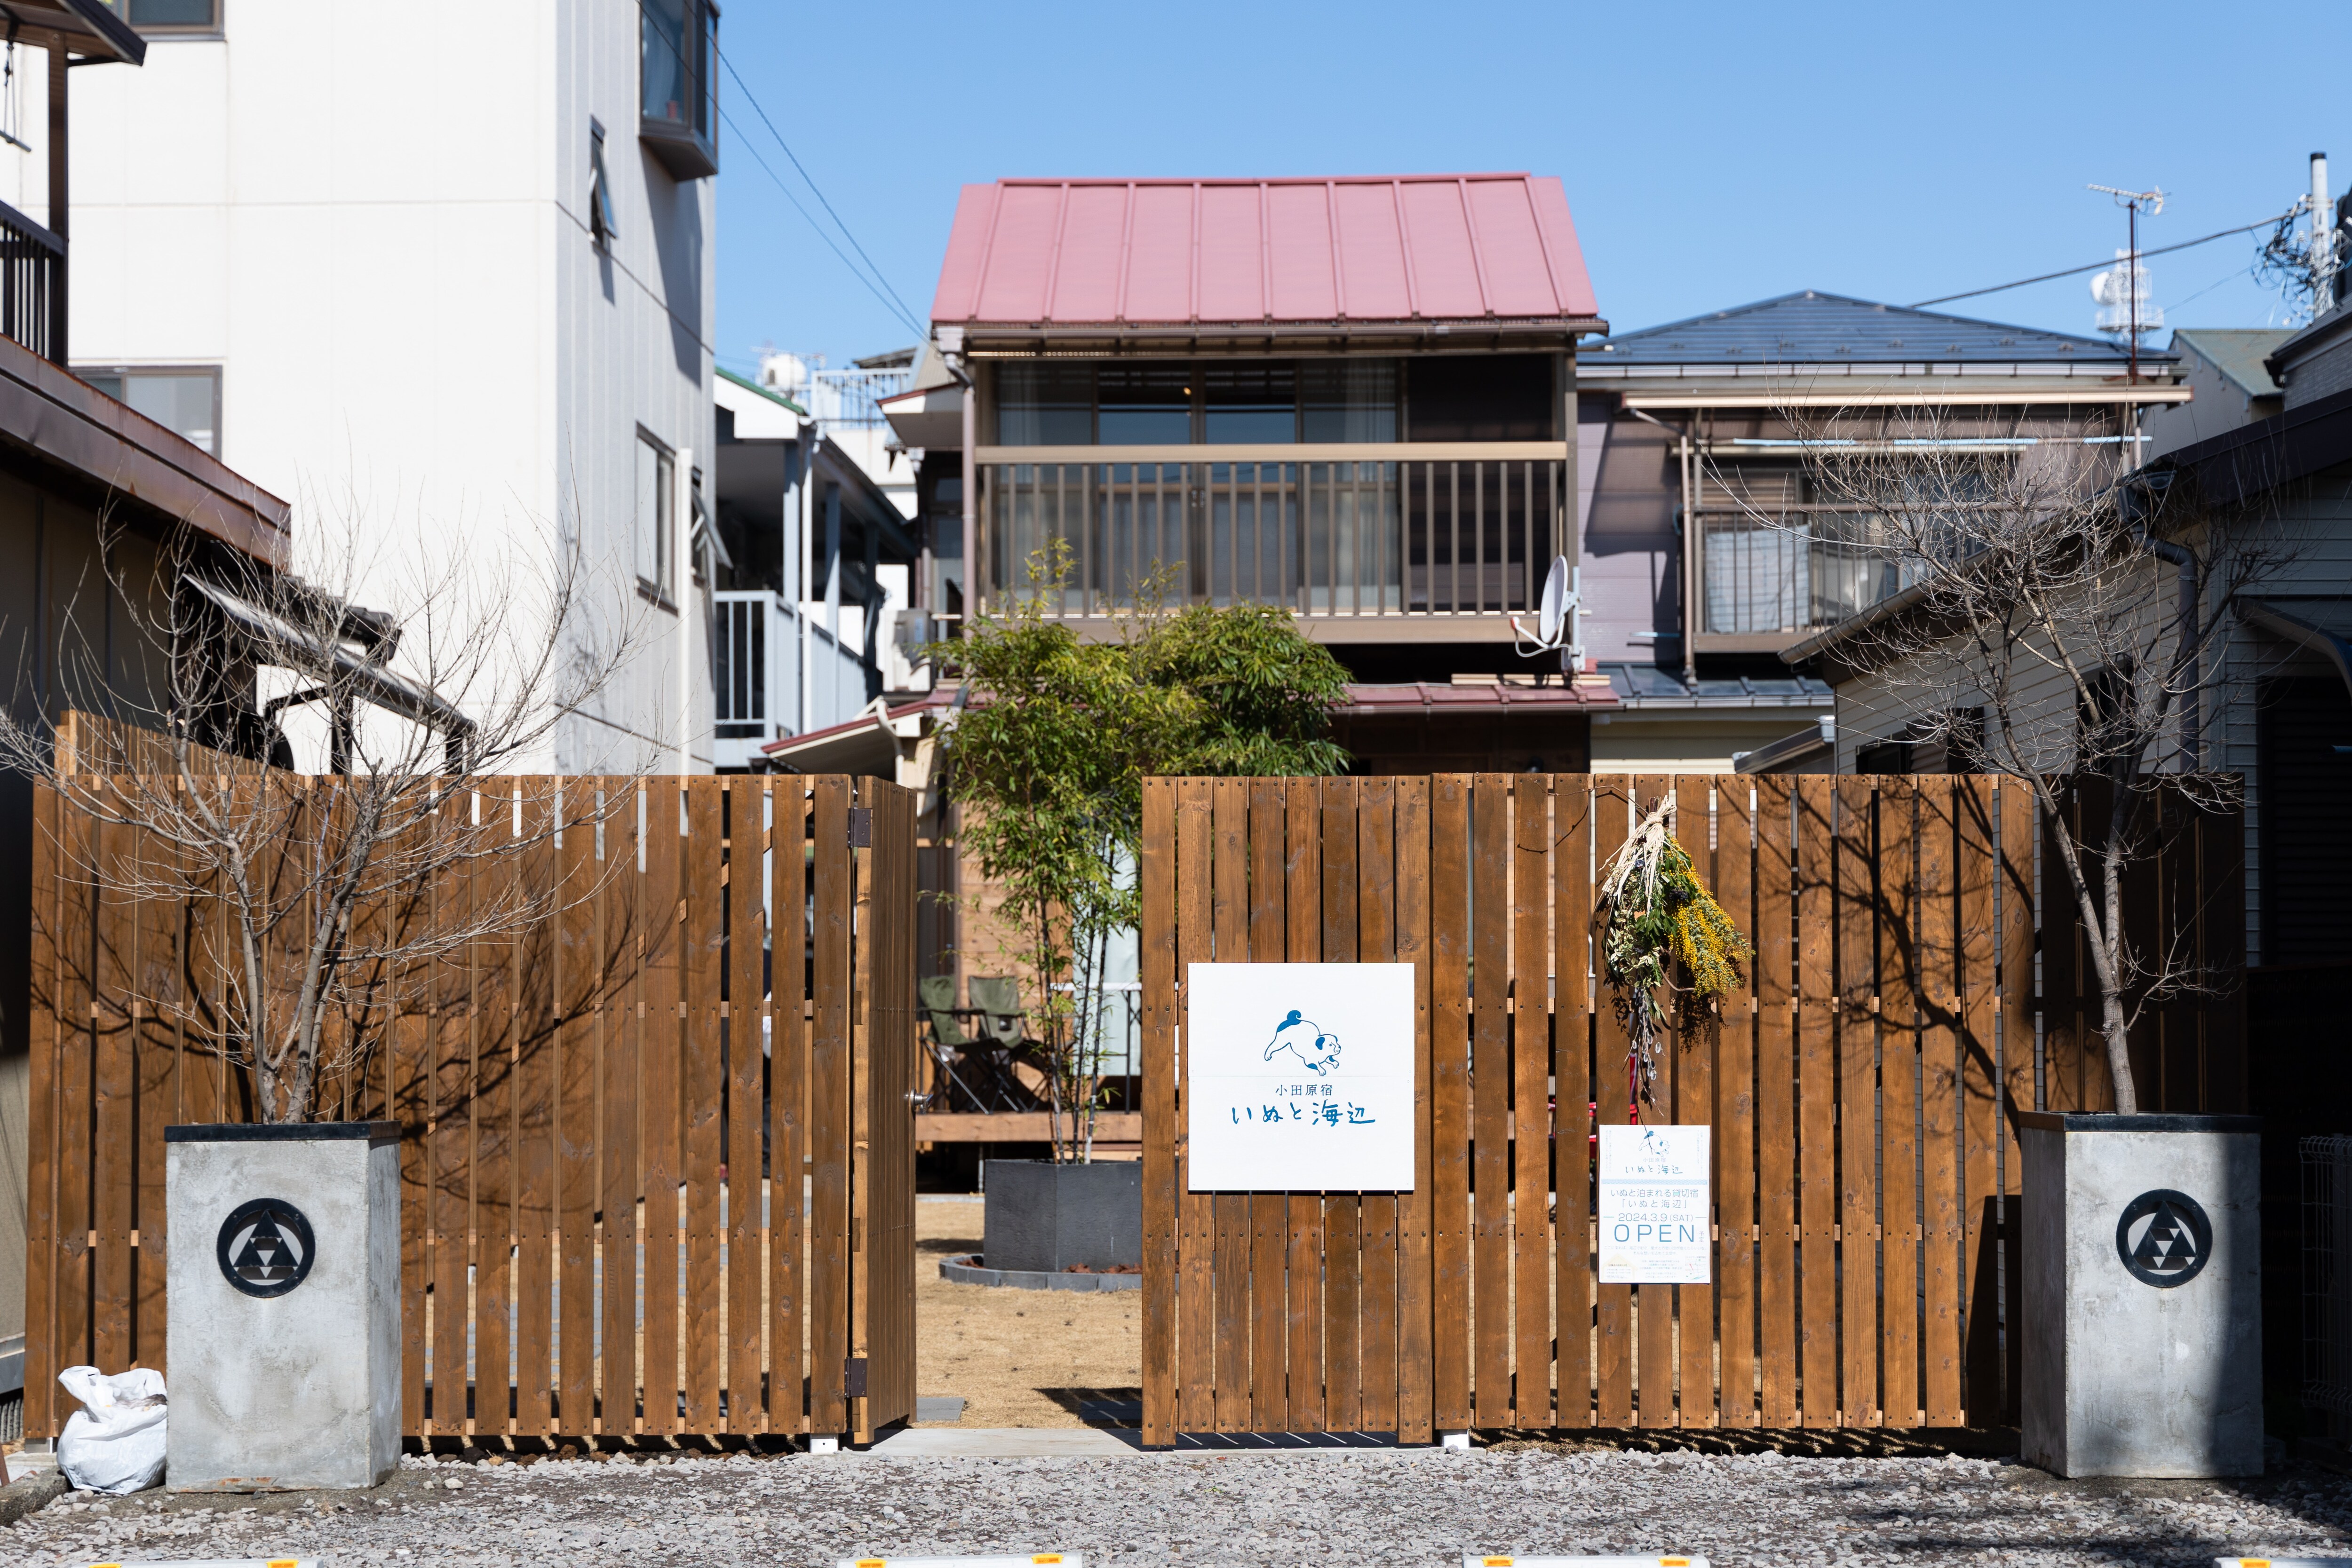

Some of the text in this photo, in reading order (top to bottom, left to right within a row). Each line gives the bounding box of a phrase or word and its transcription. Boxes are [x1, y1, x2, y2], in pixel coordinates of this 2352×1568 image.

[1275, 1084, 1333, 1096] 小田原宿
[1232, 1099, 1376, 1127] いぬと海辺
[1625, 1164, 1683, 1175] いぬと海辺
[1611, 1189, 1699, 1198] いぬと泊まれる貸切宿
[1622, 1199, 1687, 1209] 「いぬと海辺」
[1618, 1213, 1667, 1222] 2024.3.9
[1614, 1224, 1694, 1242] OPEN
[1699, 1231, 1705, 1243] 予定
